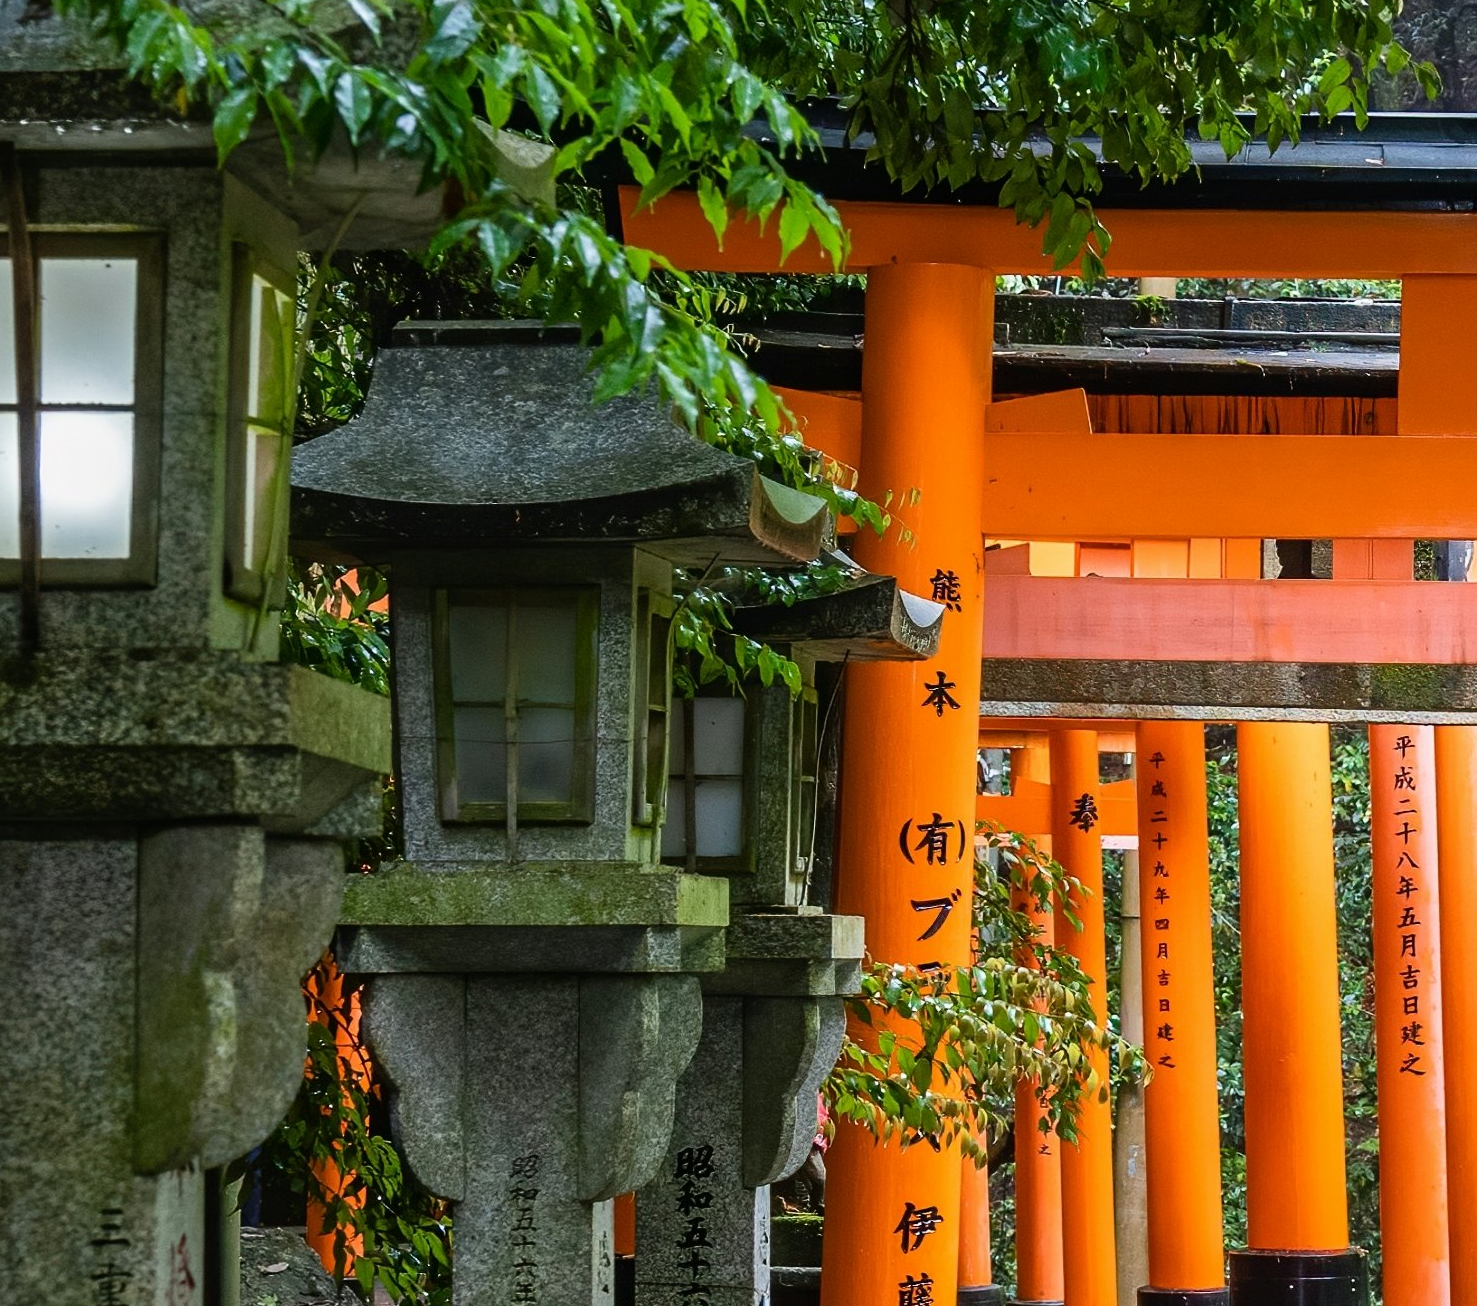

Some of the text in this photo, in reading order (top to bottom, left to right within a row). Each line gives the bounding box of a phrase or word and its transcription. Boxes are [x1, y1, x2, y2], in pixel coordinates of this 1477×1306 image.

[922, 568, 962, 717] 熊本
[1069, 793, 1099, 834] 奉
[1148, 751, 1177, 1070] 平成二十九年四月吉日建之
[1393, 735, 1426, 1077] 平成二十八年五月吉日建之
